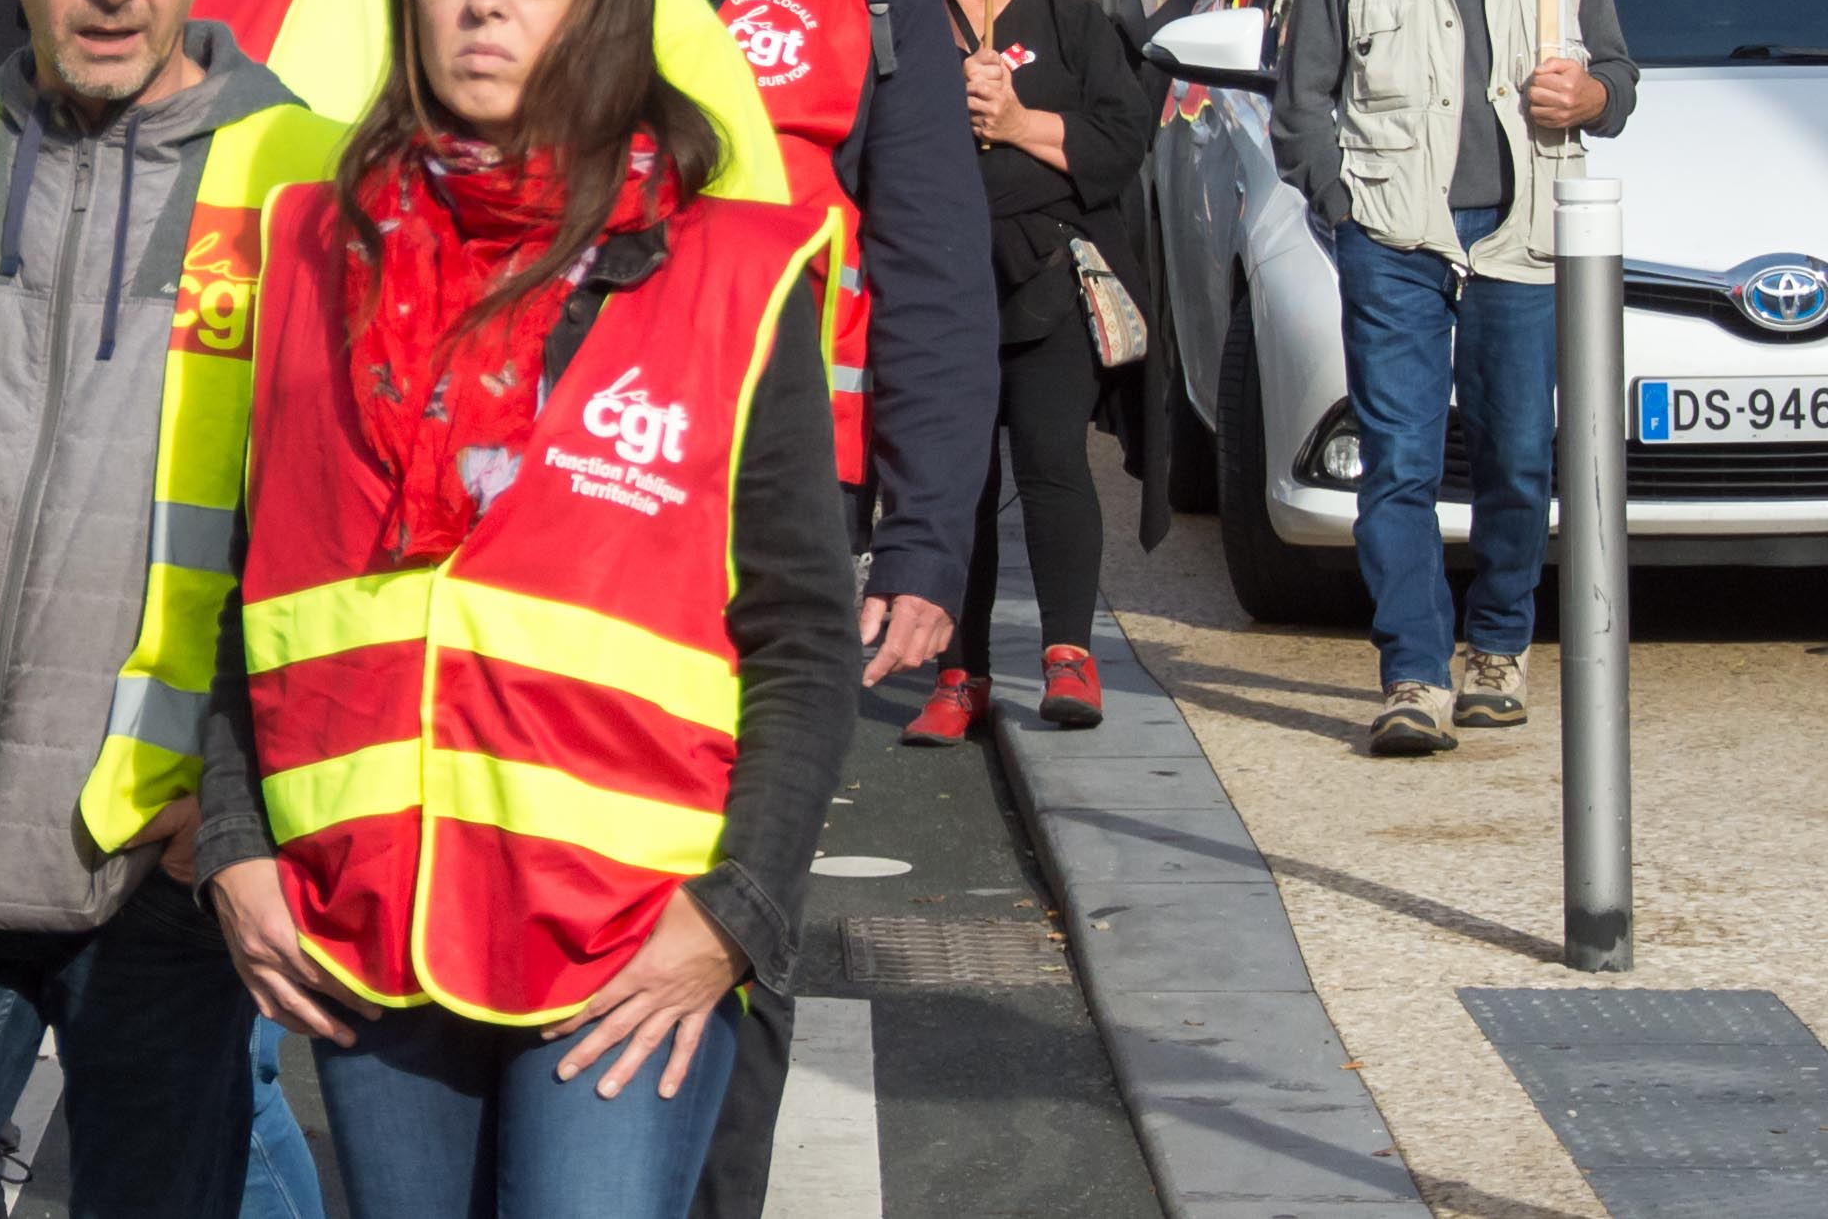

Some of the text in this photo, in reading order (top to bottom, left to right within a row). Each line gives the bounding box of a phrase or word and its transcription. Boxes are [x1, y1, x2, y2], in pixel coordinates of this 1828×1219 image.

[728, 22, 804, 66] cgt
[757, 62, 811, 87] SUR YON
[583, 398, 689, 464] cgt
[545, 447, 687, 505] Fonction Publique
[571, 474, 660, 516] Territoriale
